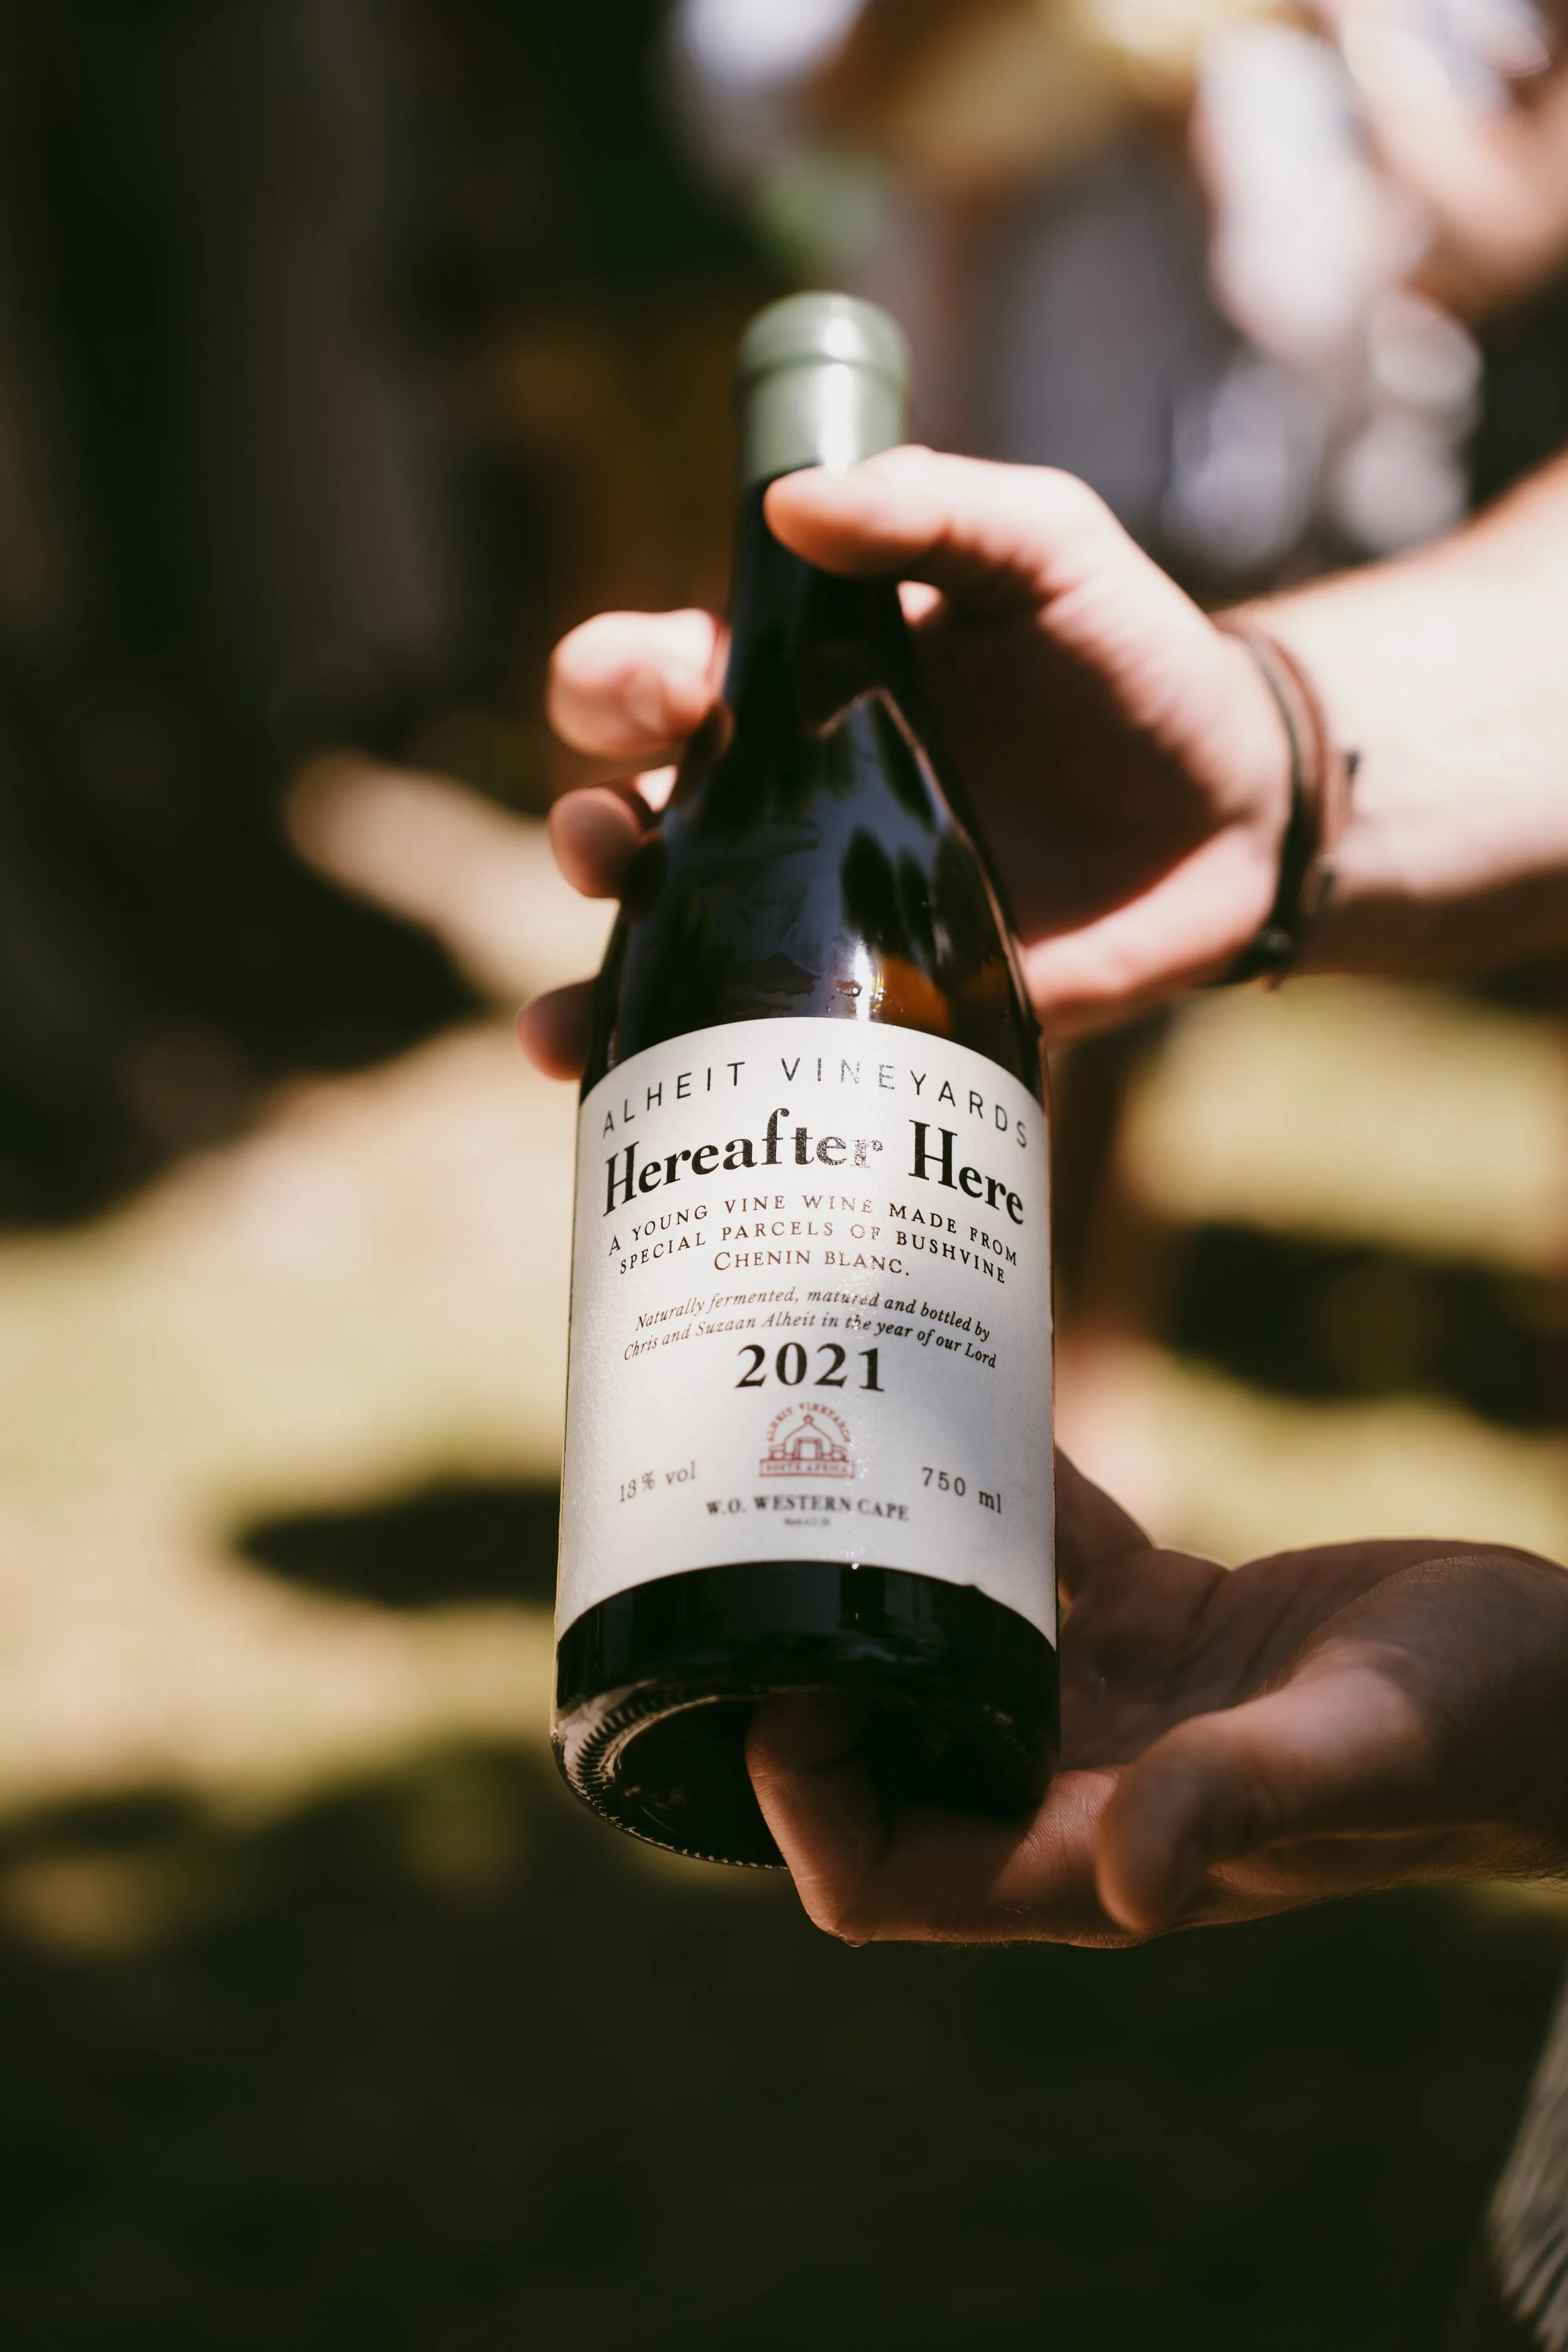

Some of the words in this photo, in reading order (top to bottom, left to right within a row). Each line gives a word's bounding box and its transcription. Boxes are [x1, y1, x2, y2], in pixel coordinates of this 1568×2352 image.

[603, 1061, 746, 1138] ALHEIT
[781, 1057, 1027, 1148] VINEYARDS
[603, 1108, 884, 1217] Hereafter
[908, 1119, 1024, 1225] Here
[609, 1235, 621, 1256] A
[632, 1205, 708, 1241] YOUNG
[724, 1195, 785, 1214] VINE
[802, 1194, 873, 1214] WINE
[889, 1203, 956, 1234] MADE
[970, 1226, 1017, 1267] FROM
[620, 1232, 706, 1274] SPECIAL
[721, 1221, 834, 1242] PARCELS
[850, 1224, 881, 1241] OF
[896, 1231, 1005, 1285] BUSHVINE
[714, 1251, 811, 1271] CHENIN
[824, 1251, 909, 1276] BLANC.
[624, 1337, 658, 1360] Chris
[662, 1323, 691, 1346] and
[696, 1321, 756, 1337] Suzaan
[761, 1311, 816, 1328] Alheit
[821, 1312, 839, 1328] in
[845, 1313, 871, 1330] the
[873, 1321, 913, 1336] year
[917, 1328, 935, 1346] of
[936, 1335, 962, 1352] our
[964, 1342, 997, 1369] Lord
[635, 1297, 705, 1332] Naturally
[706, 1286, 798, 1314] fermented,
[807, 1290, 881, 1307] matured
[884, 1299, 916, 1315] and
[921, 1302, 972, 1332] bottled
[975, 1321, 990, 1342] by
[734, 1342, 885, 1392] 2021
[620, 1468, 655, 1503] 13%
[665, 1460, 696, 1484] vol
[706, 1498, 747, 1516] W.O.
[754, 1495, 852, 1512] WESTERN
[857, 1498, 910, 1522] CAPE
[922, 1466, 966, 1497] 750
[978, 1490, 1002, 1515] ml
